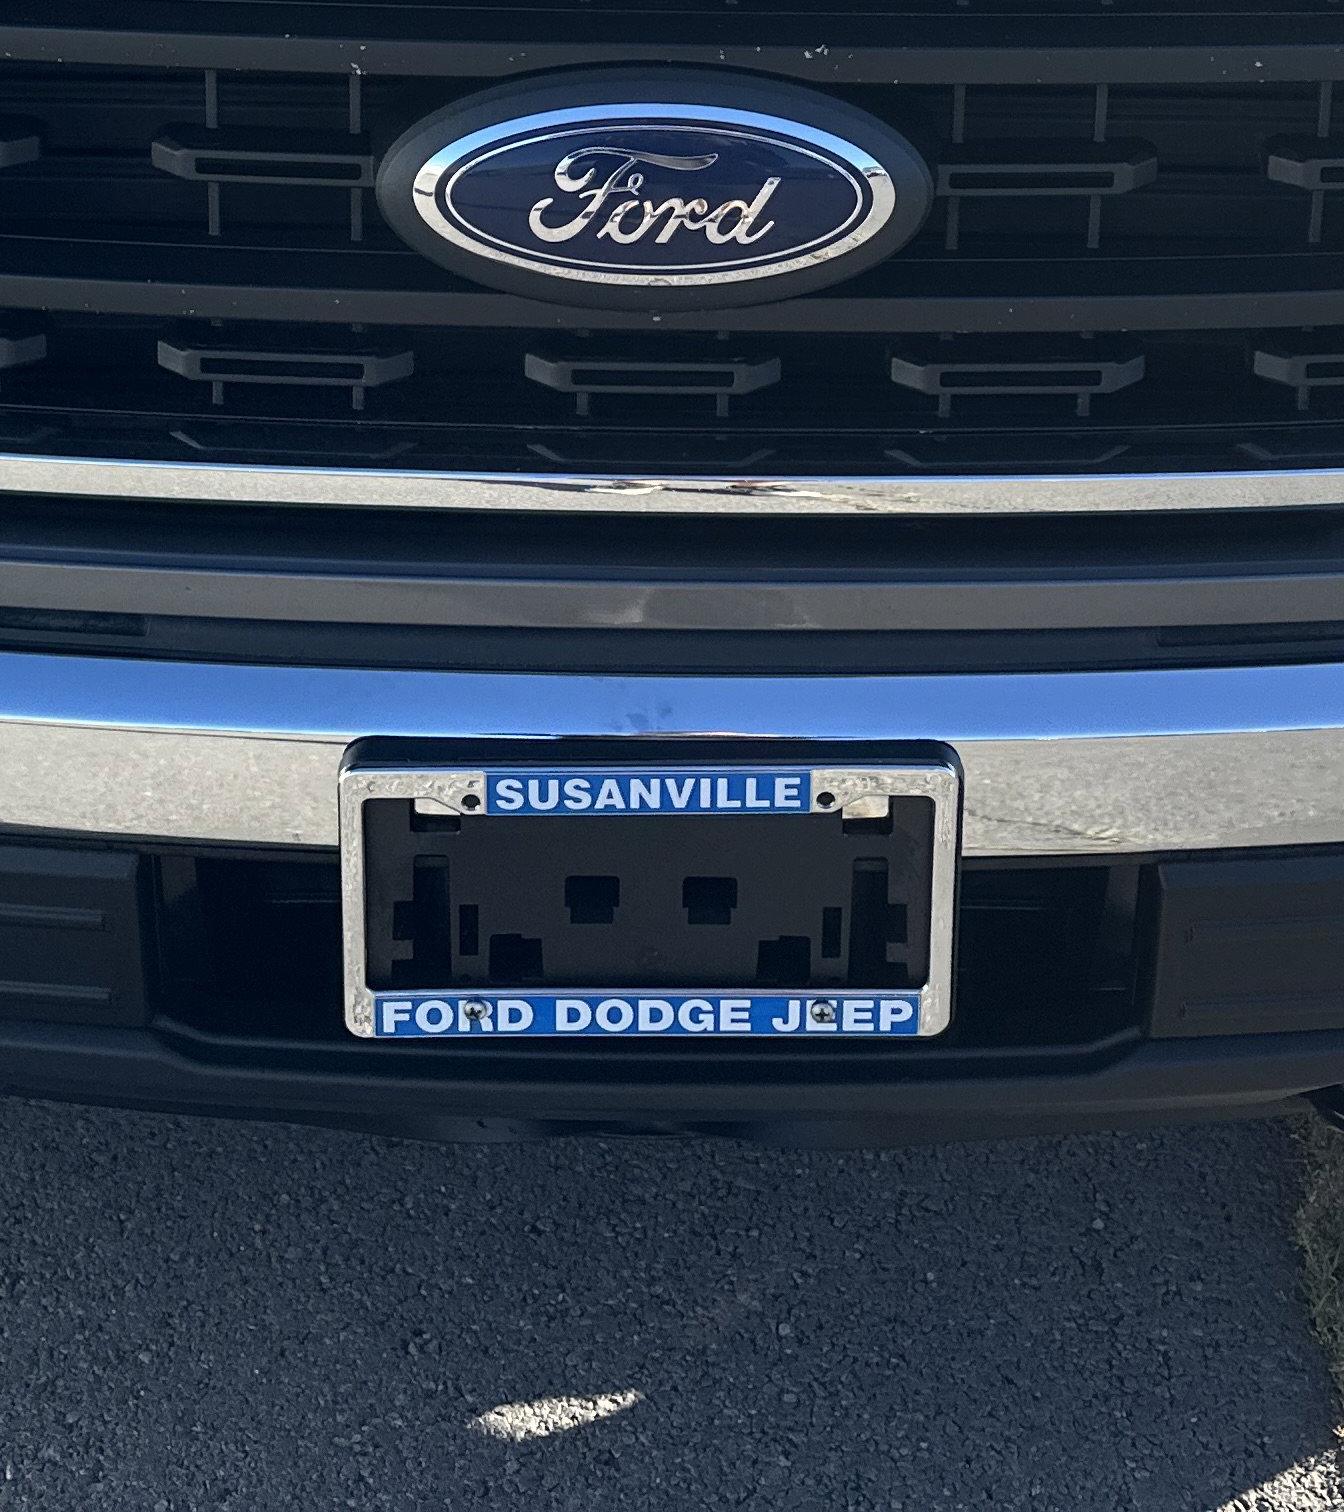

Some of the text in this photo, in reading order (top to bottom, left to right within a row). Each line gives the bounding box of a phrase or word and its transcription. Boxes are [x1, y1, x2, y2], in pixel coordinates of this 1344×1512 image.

[529, 146, 781, 244] Ford
[494, 775, 803, 810] SUSANVILLE
[555, 998, 752, 1033] DODGE
